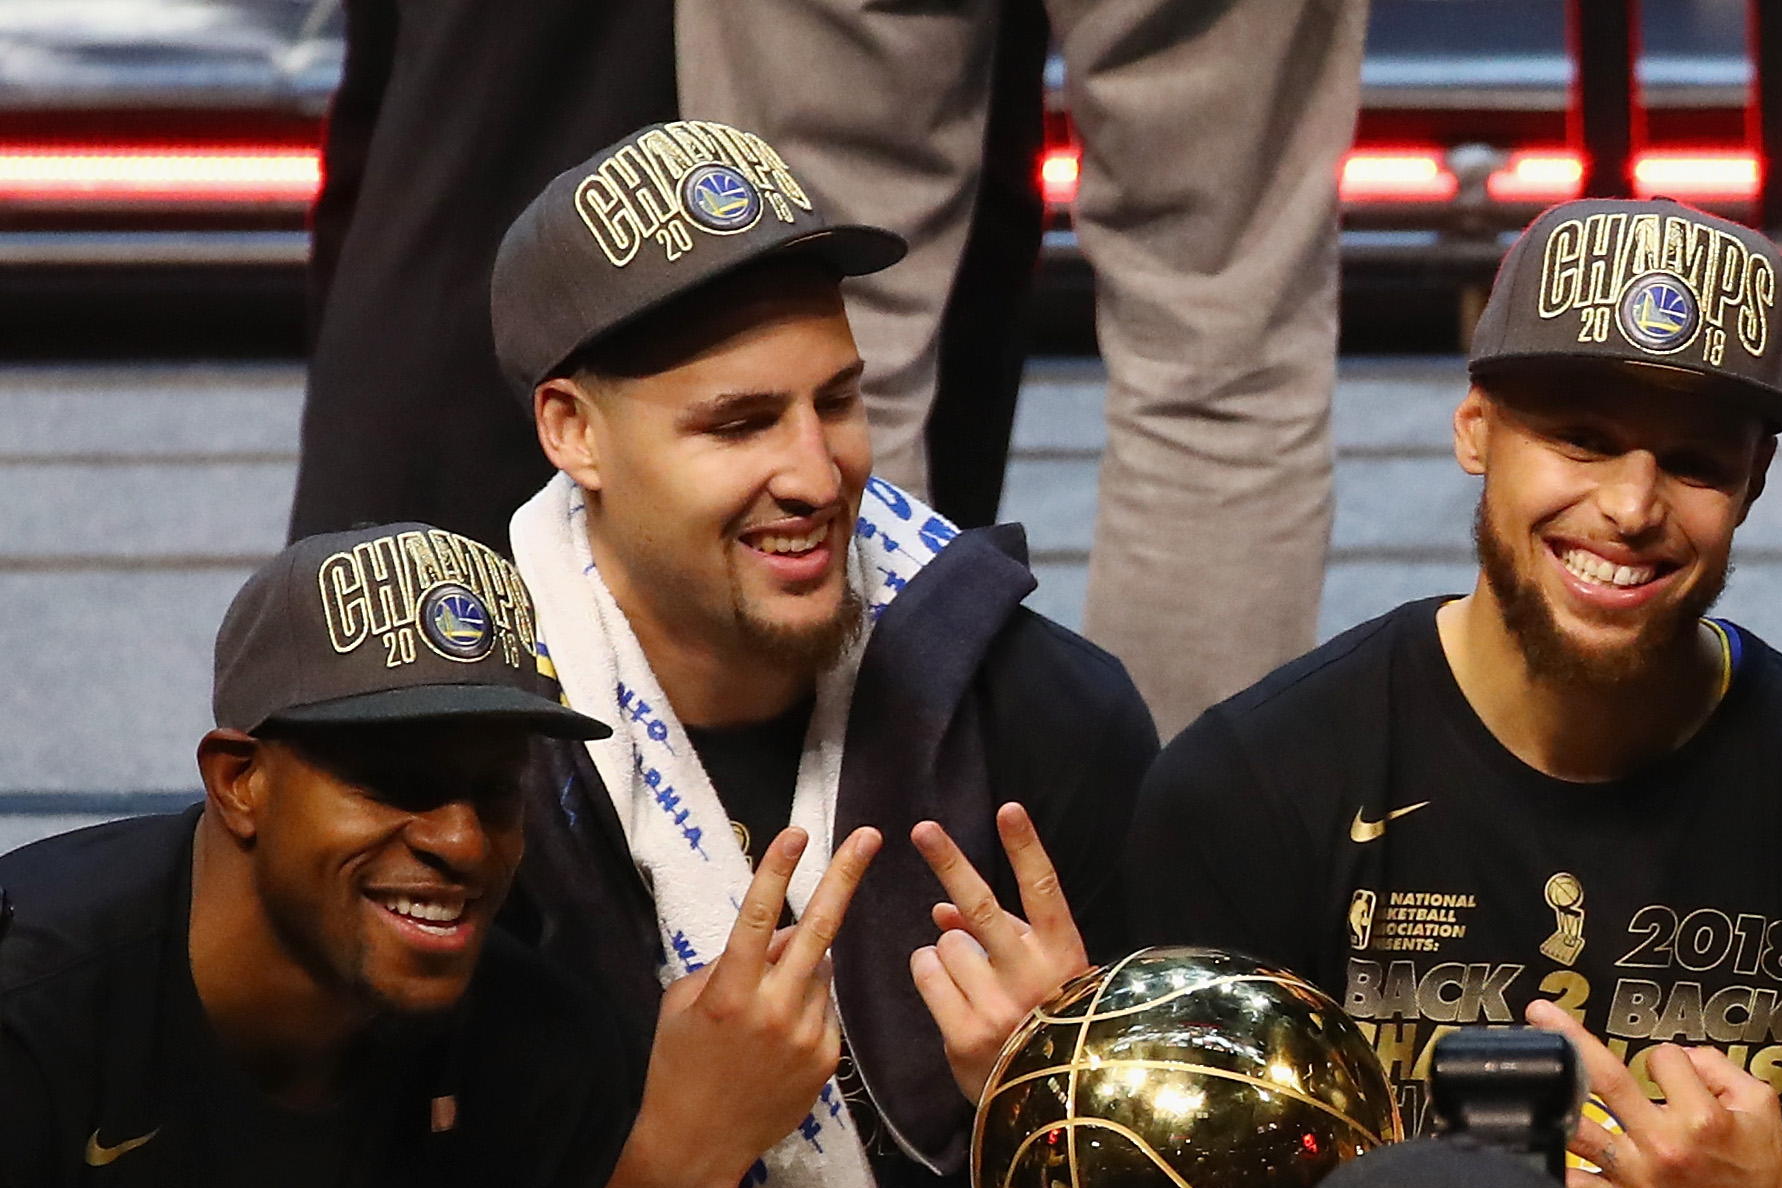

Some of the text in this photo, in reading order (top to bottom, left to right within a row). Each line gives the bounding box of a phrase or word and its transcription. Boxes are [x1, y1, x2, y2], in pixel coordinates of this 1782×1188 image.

[574, 119, 813, 267] CHAMPS
[656, 220, 694, 262] 20
[1538, 213, 1776, 358] CHAMPS
[1577, 306, 1728, 367] 20 18
[318, 529, 538, 654] CHAMPS
[383, 628, 417, 668] 20
[1385, 907, 1458, 923] KETBALL
[1389, 891, 1477, 908] NATIONAL
[1384, 922, 1467, 938] OCIATION
[1344, 957, 1525, 1024] BACK
